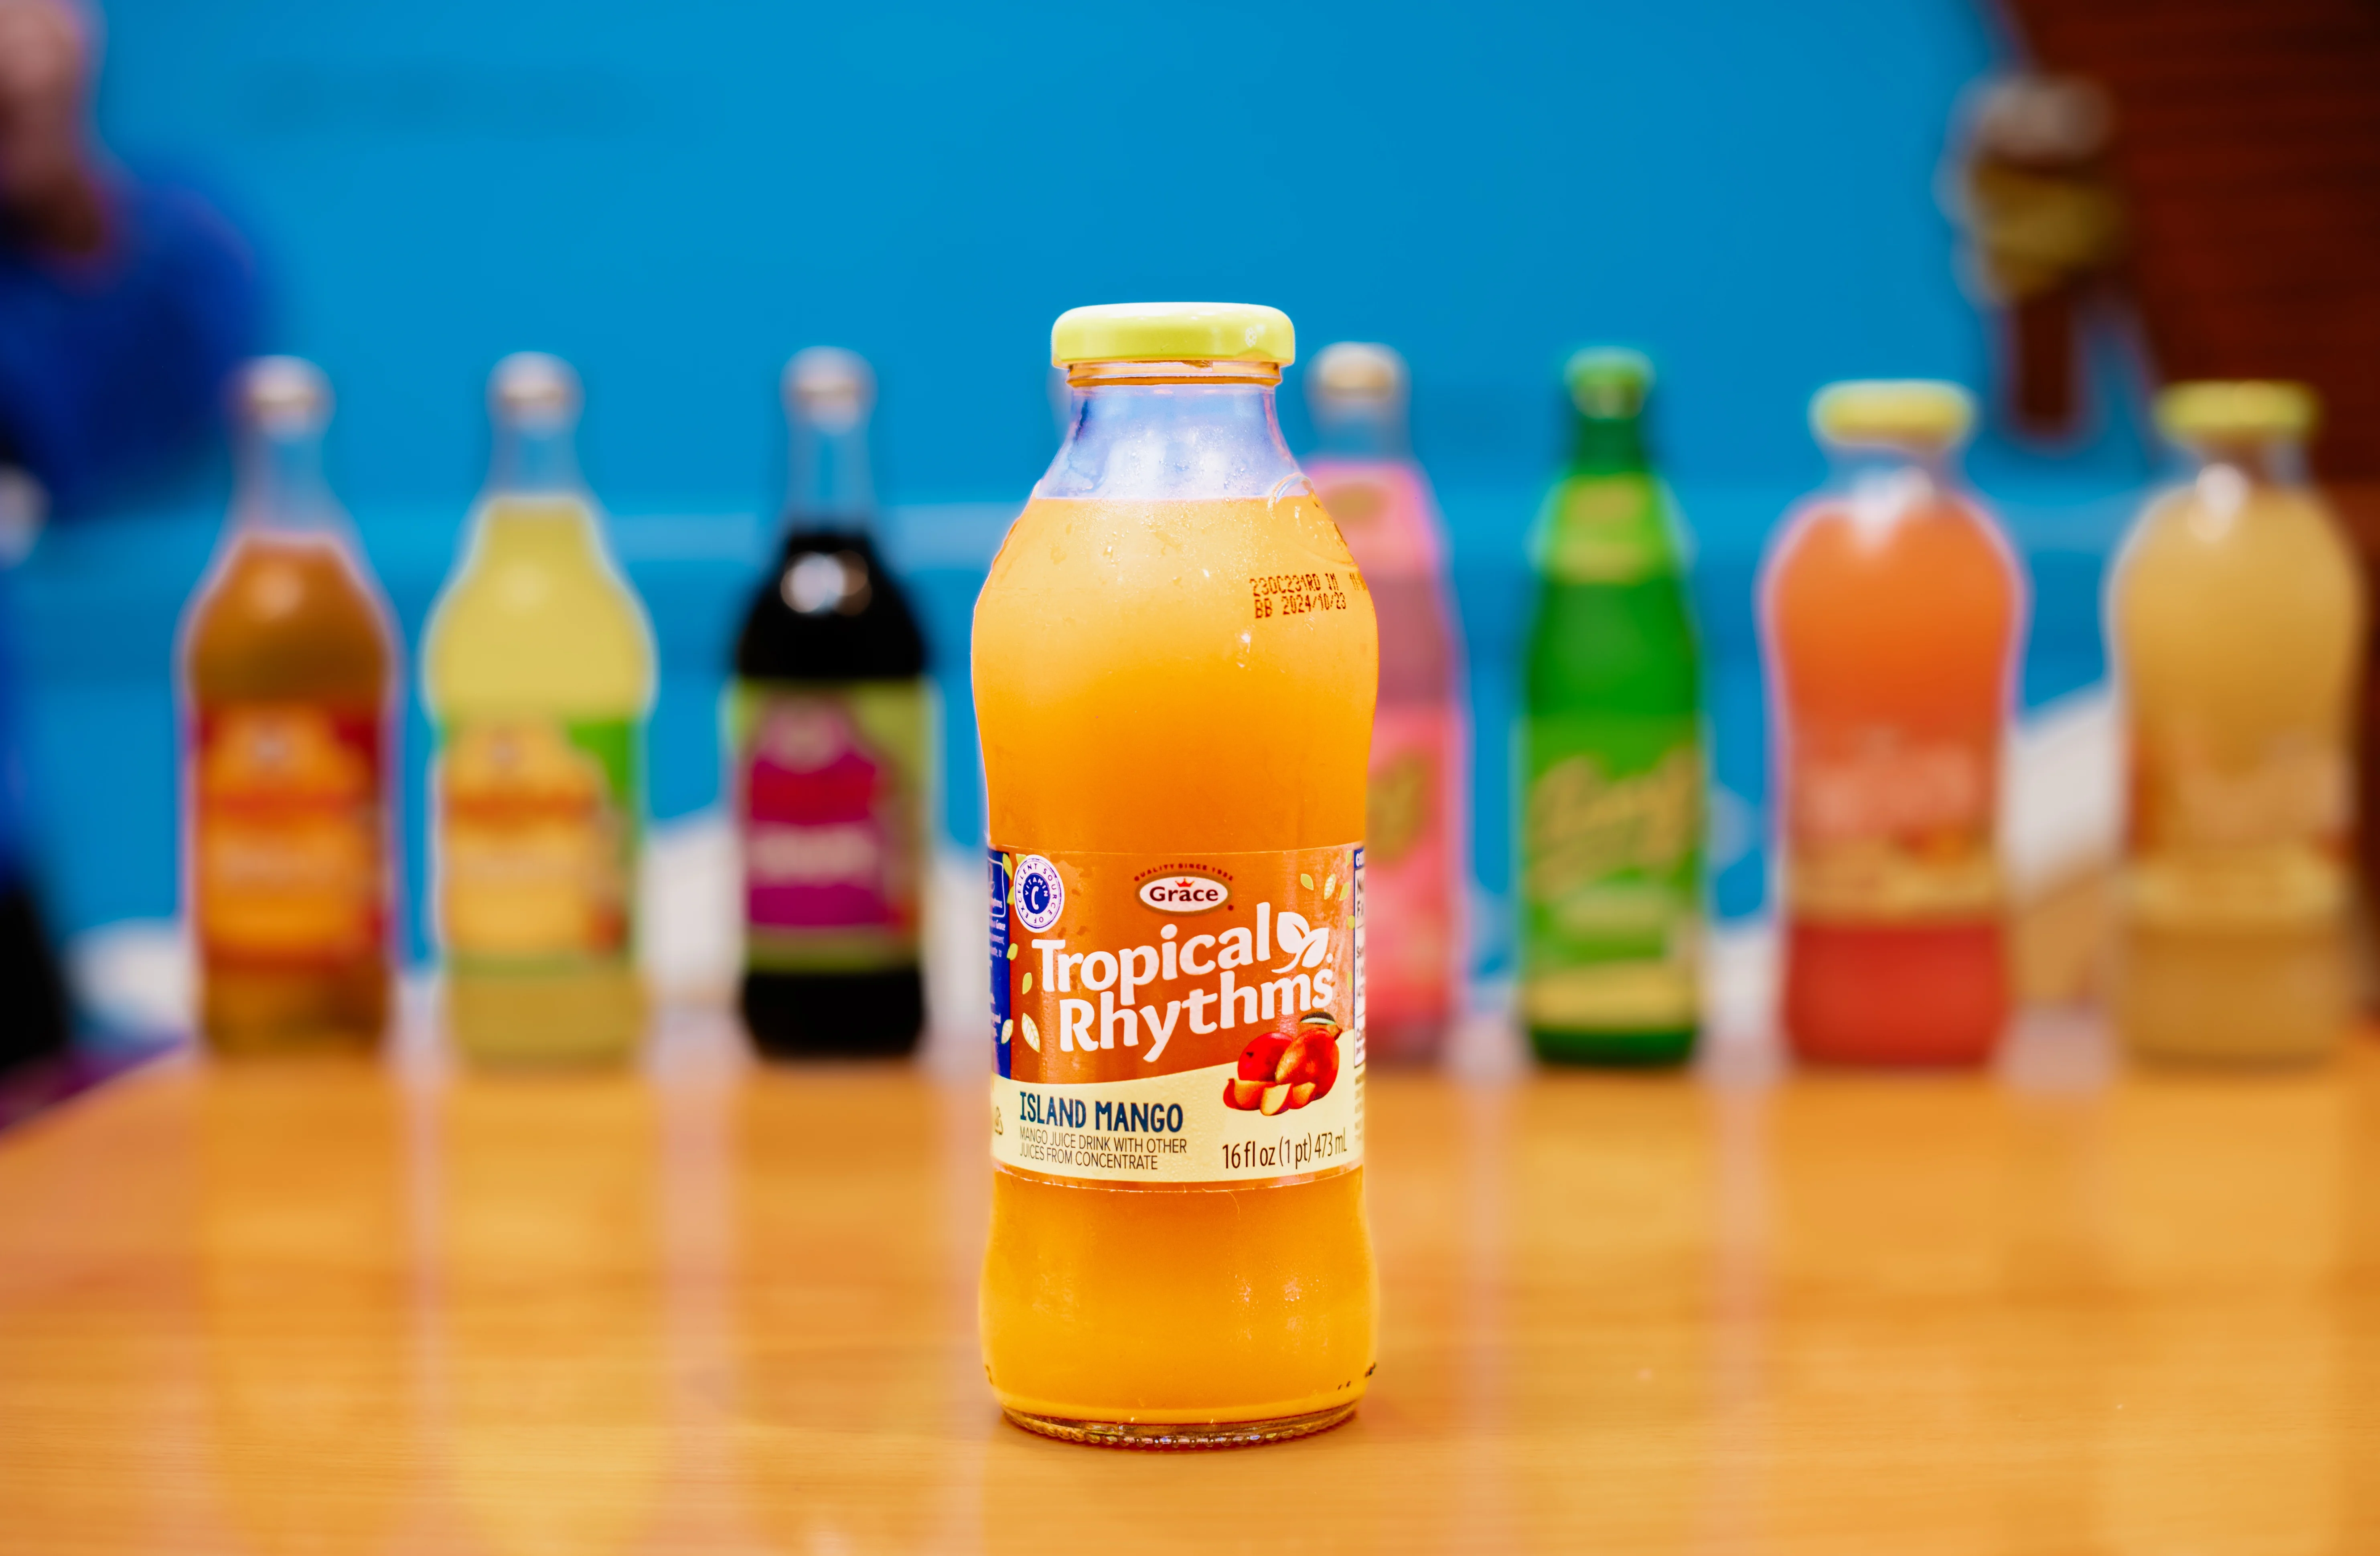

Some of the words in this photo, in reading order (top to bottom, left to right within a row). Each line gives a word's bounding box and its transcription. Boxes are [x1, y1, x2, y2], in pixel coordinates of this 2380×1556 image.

[1255, 598, 1273, 619] BB
[1281, 592, 1346, 615] 2024/10/23
[1018, 863, 1037, 918] EXCELLENT
[1043, 868, 1057, 916] SOURCE
[1025, 877, 1048, 897] VITAMIN
[1031, 886, 1039, 910] C
[1149, 886, 1218, 902] Grace
[1032, 902, 1271, 1006] Tropical
[1060, 968, 1333, 1062] Rhythms
[1020, 1091, 1086, 1128] ISLAND
[1095, 1101, 1183, 1133] MANGO
[1020, 1126, 1048, 1145] MANGO
[1050, 1132, 1076, 1149] JUICE
[1079, 1135, 1111, 1152] DRINK
[1114, 1137, 1142, 1153] WITH
[1147, 1139, 1187, 1153] OTHER
[1222, 1144, 1241, 1169] 16
[1244, 1141, 1255, 1167] fl
[1260, 1147, 1275, 1166] oz
[1279, 1136, 1290, 1167] (1
[1295, 1133, 1312, 1169] pt)
[1314, 1132, 1333, 1159] 473
[1335, 1127, 1347, 1154] mL
[1020, 1142, 1044, 1161] JUICES
[1047, 1147, 1072, 1165] FROM
[1075, 1151, 1158, 1170] CONCENTRATE
